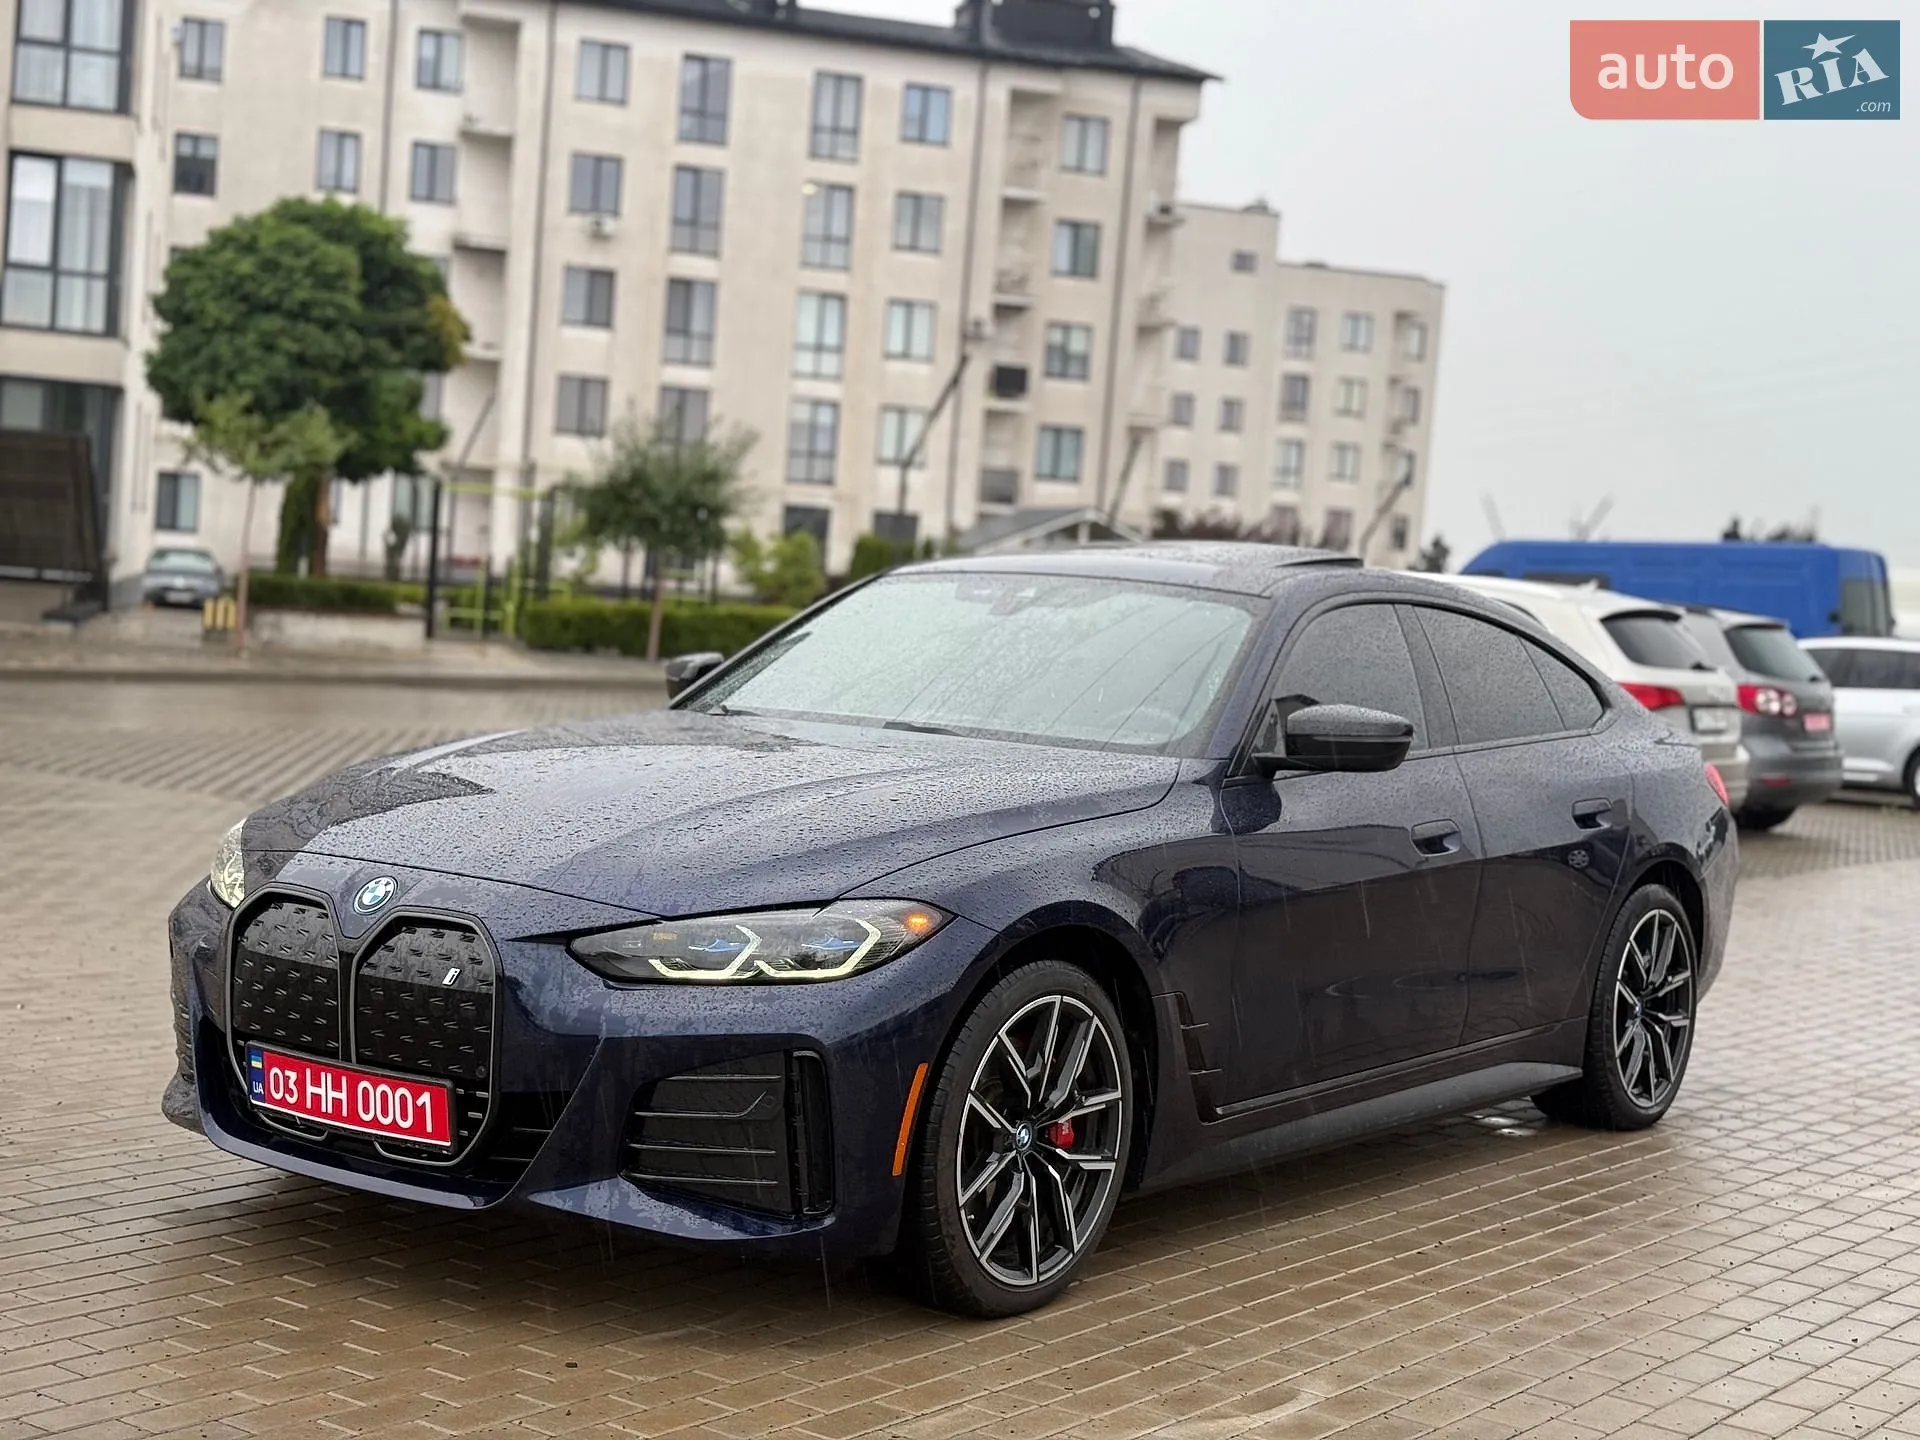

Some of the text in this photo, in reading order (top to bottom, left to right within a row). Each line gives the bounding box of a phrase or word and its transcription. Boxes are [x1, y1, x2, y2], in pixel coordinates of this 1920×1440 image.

[253, 1081, 264, 1094] UA
[269, 1066, 433, 1133] 03 HH 0001
